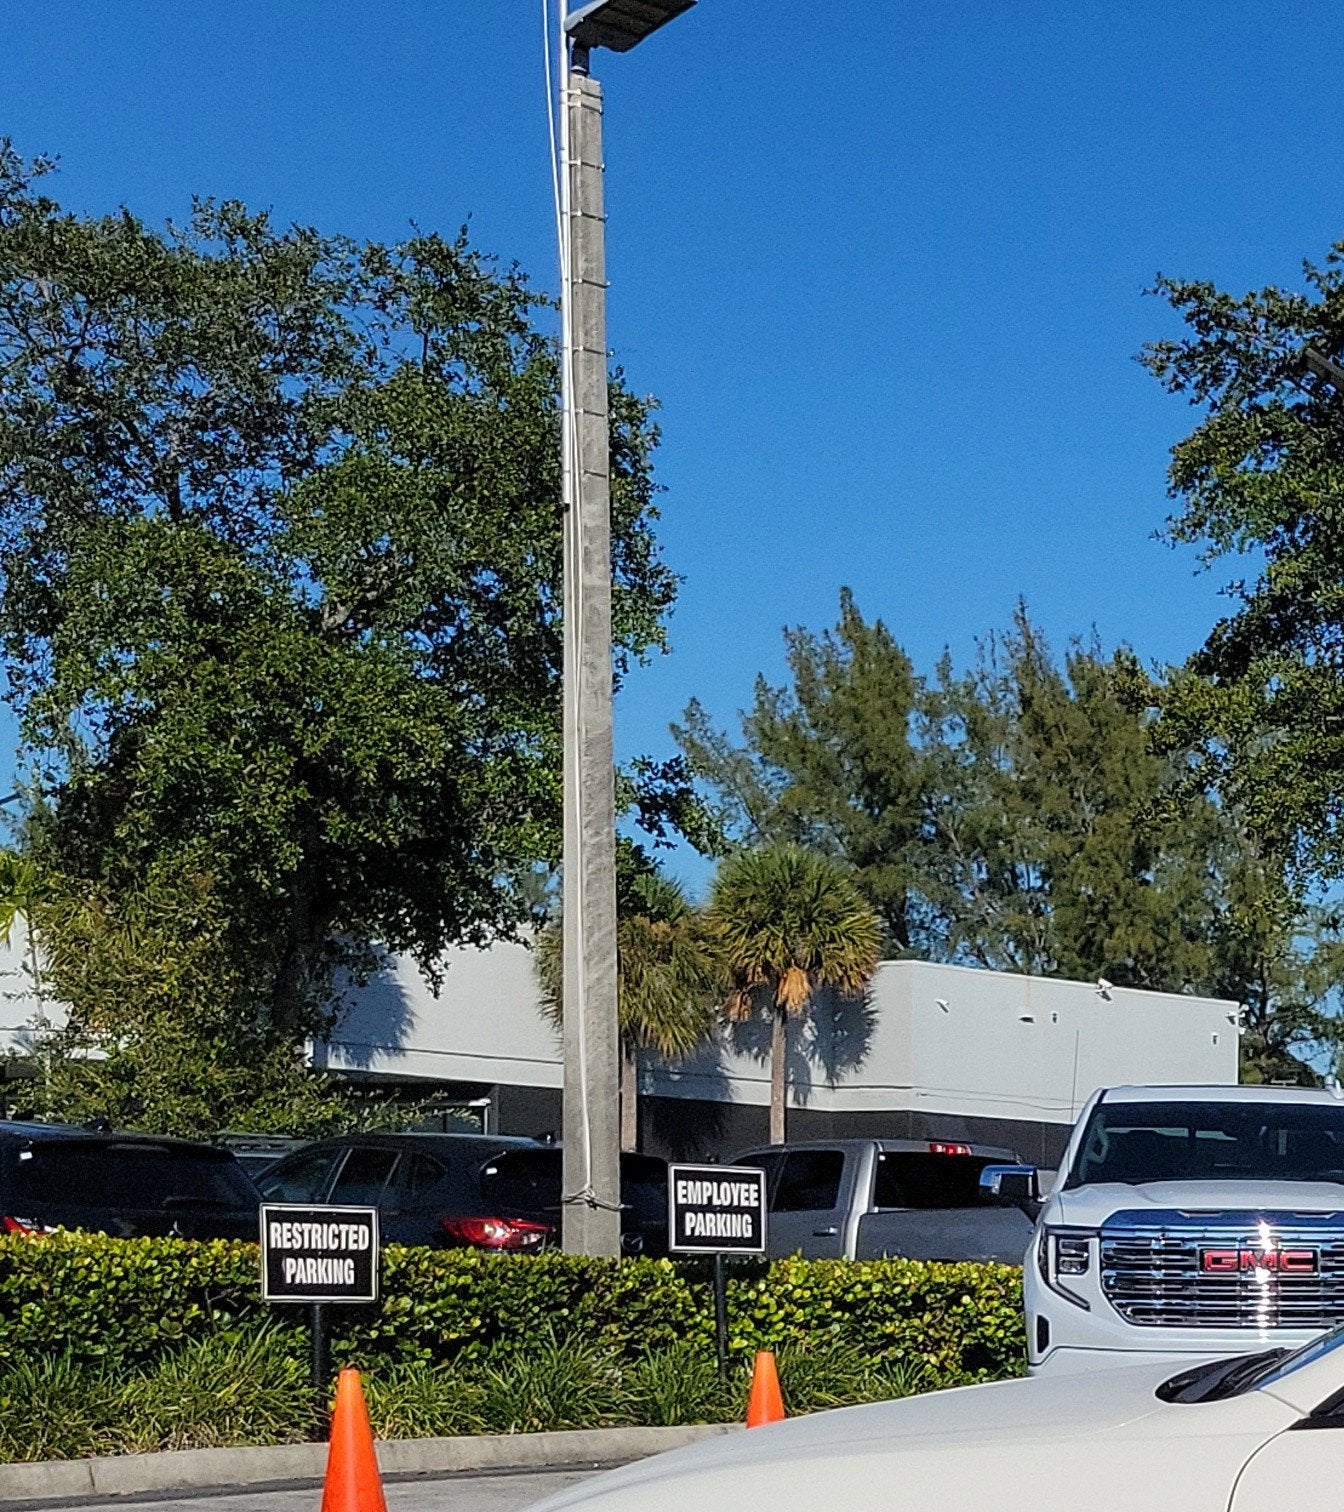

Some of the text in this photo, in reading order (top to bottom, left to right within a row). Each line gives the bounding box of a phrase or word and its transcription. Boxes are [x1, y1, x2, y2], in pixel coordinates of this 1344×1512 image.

[676, 1179, 760, 1209] EMPLOYEE
[269, 1221, 370, 1253] RESTRICTED
[684, 1211, 753, 1239] PARKING
[284, 1256, 356, 1286] PARKING
[1204, 1250, 1313, 1271] GMC
